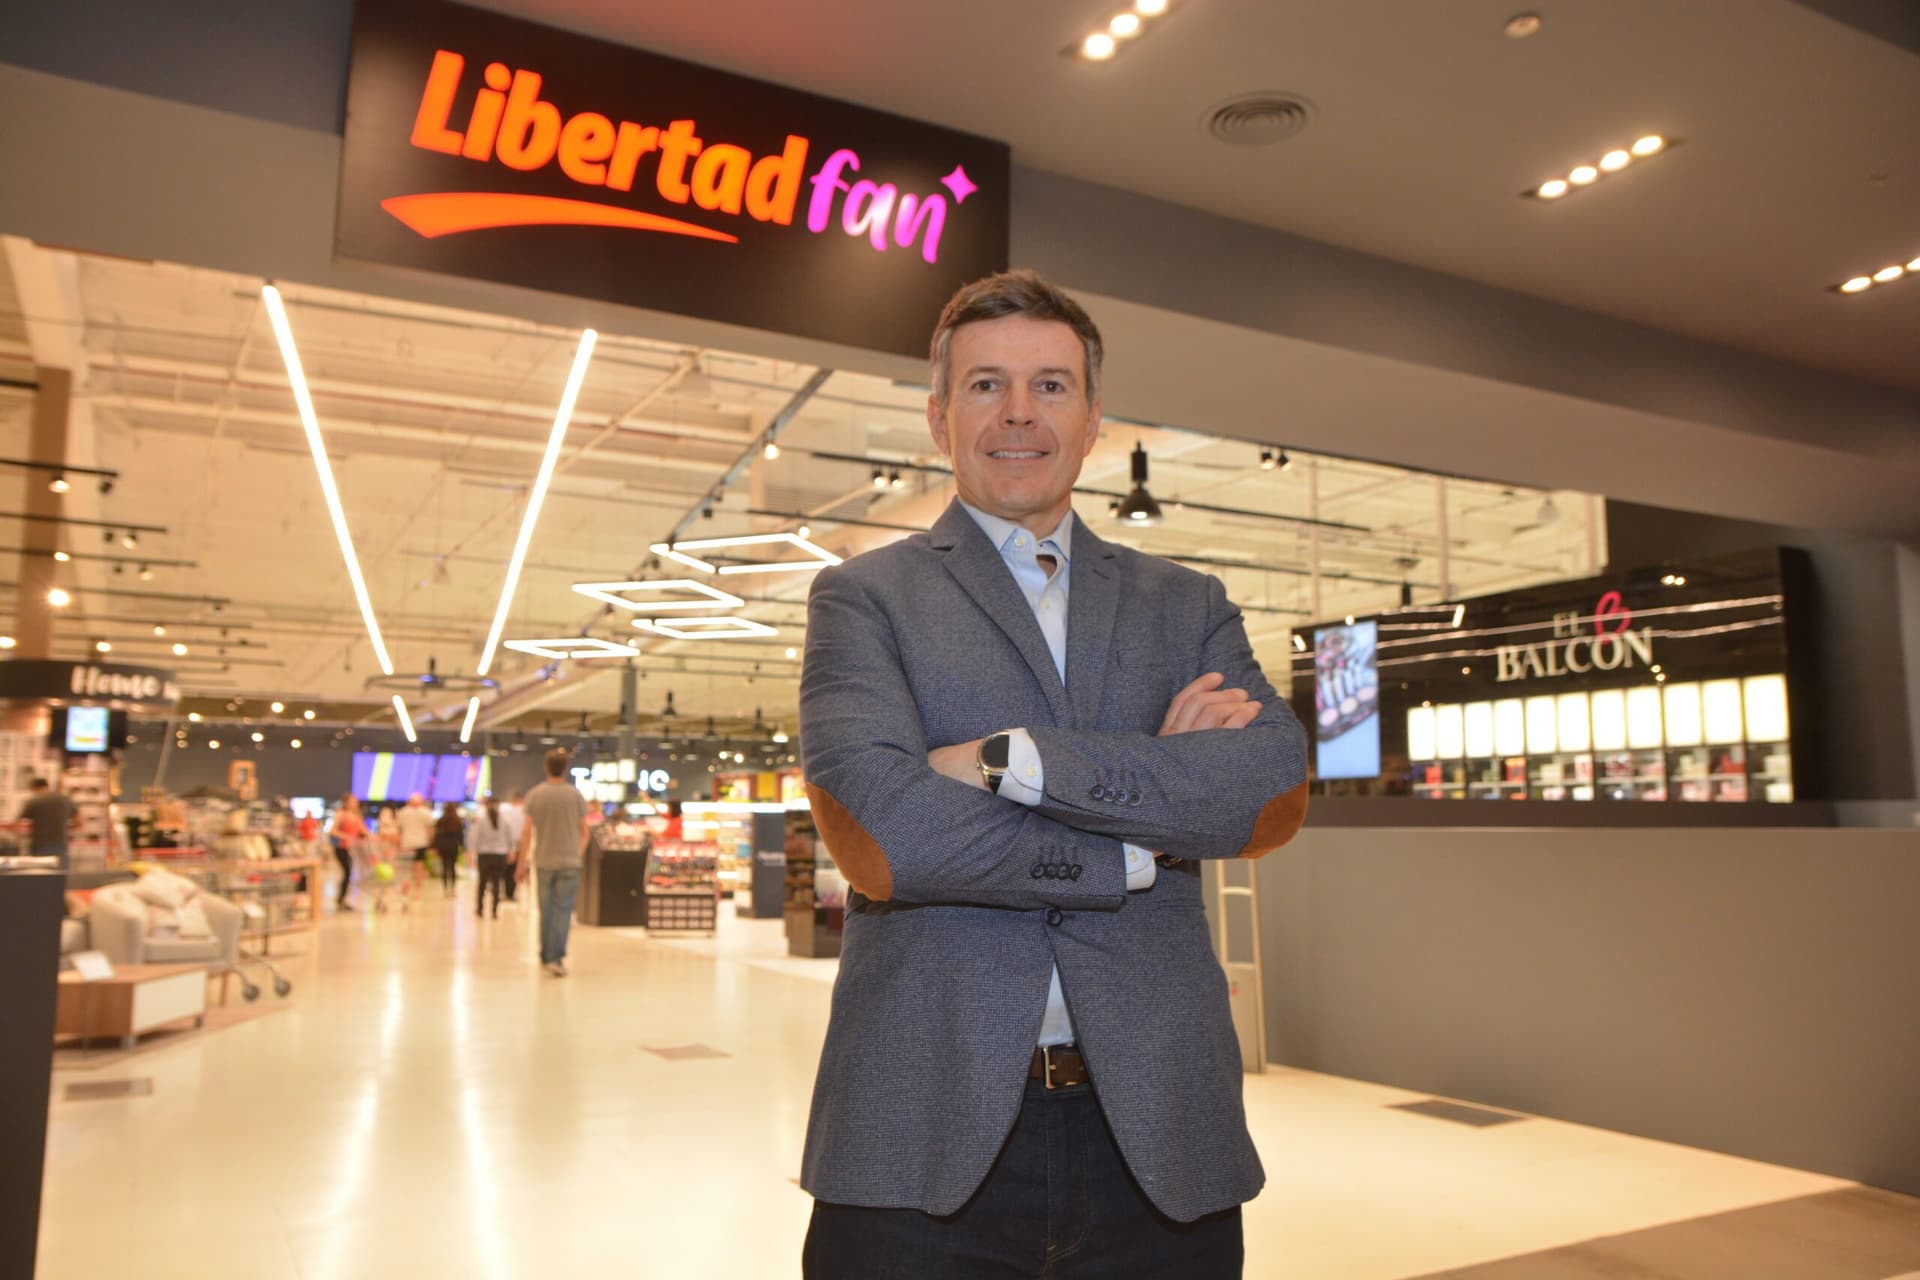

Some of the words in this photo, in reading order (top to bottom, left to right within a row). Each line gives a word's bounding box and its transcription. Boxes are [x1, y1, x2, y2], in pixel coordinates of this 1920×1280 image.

[411, 50, 809, 226] Libertad
[807, 148, 948, 264] fan
[1553, 611, 1587, 638] EL
[1496, 626, 1653, 682] BALCON
